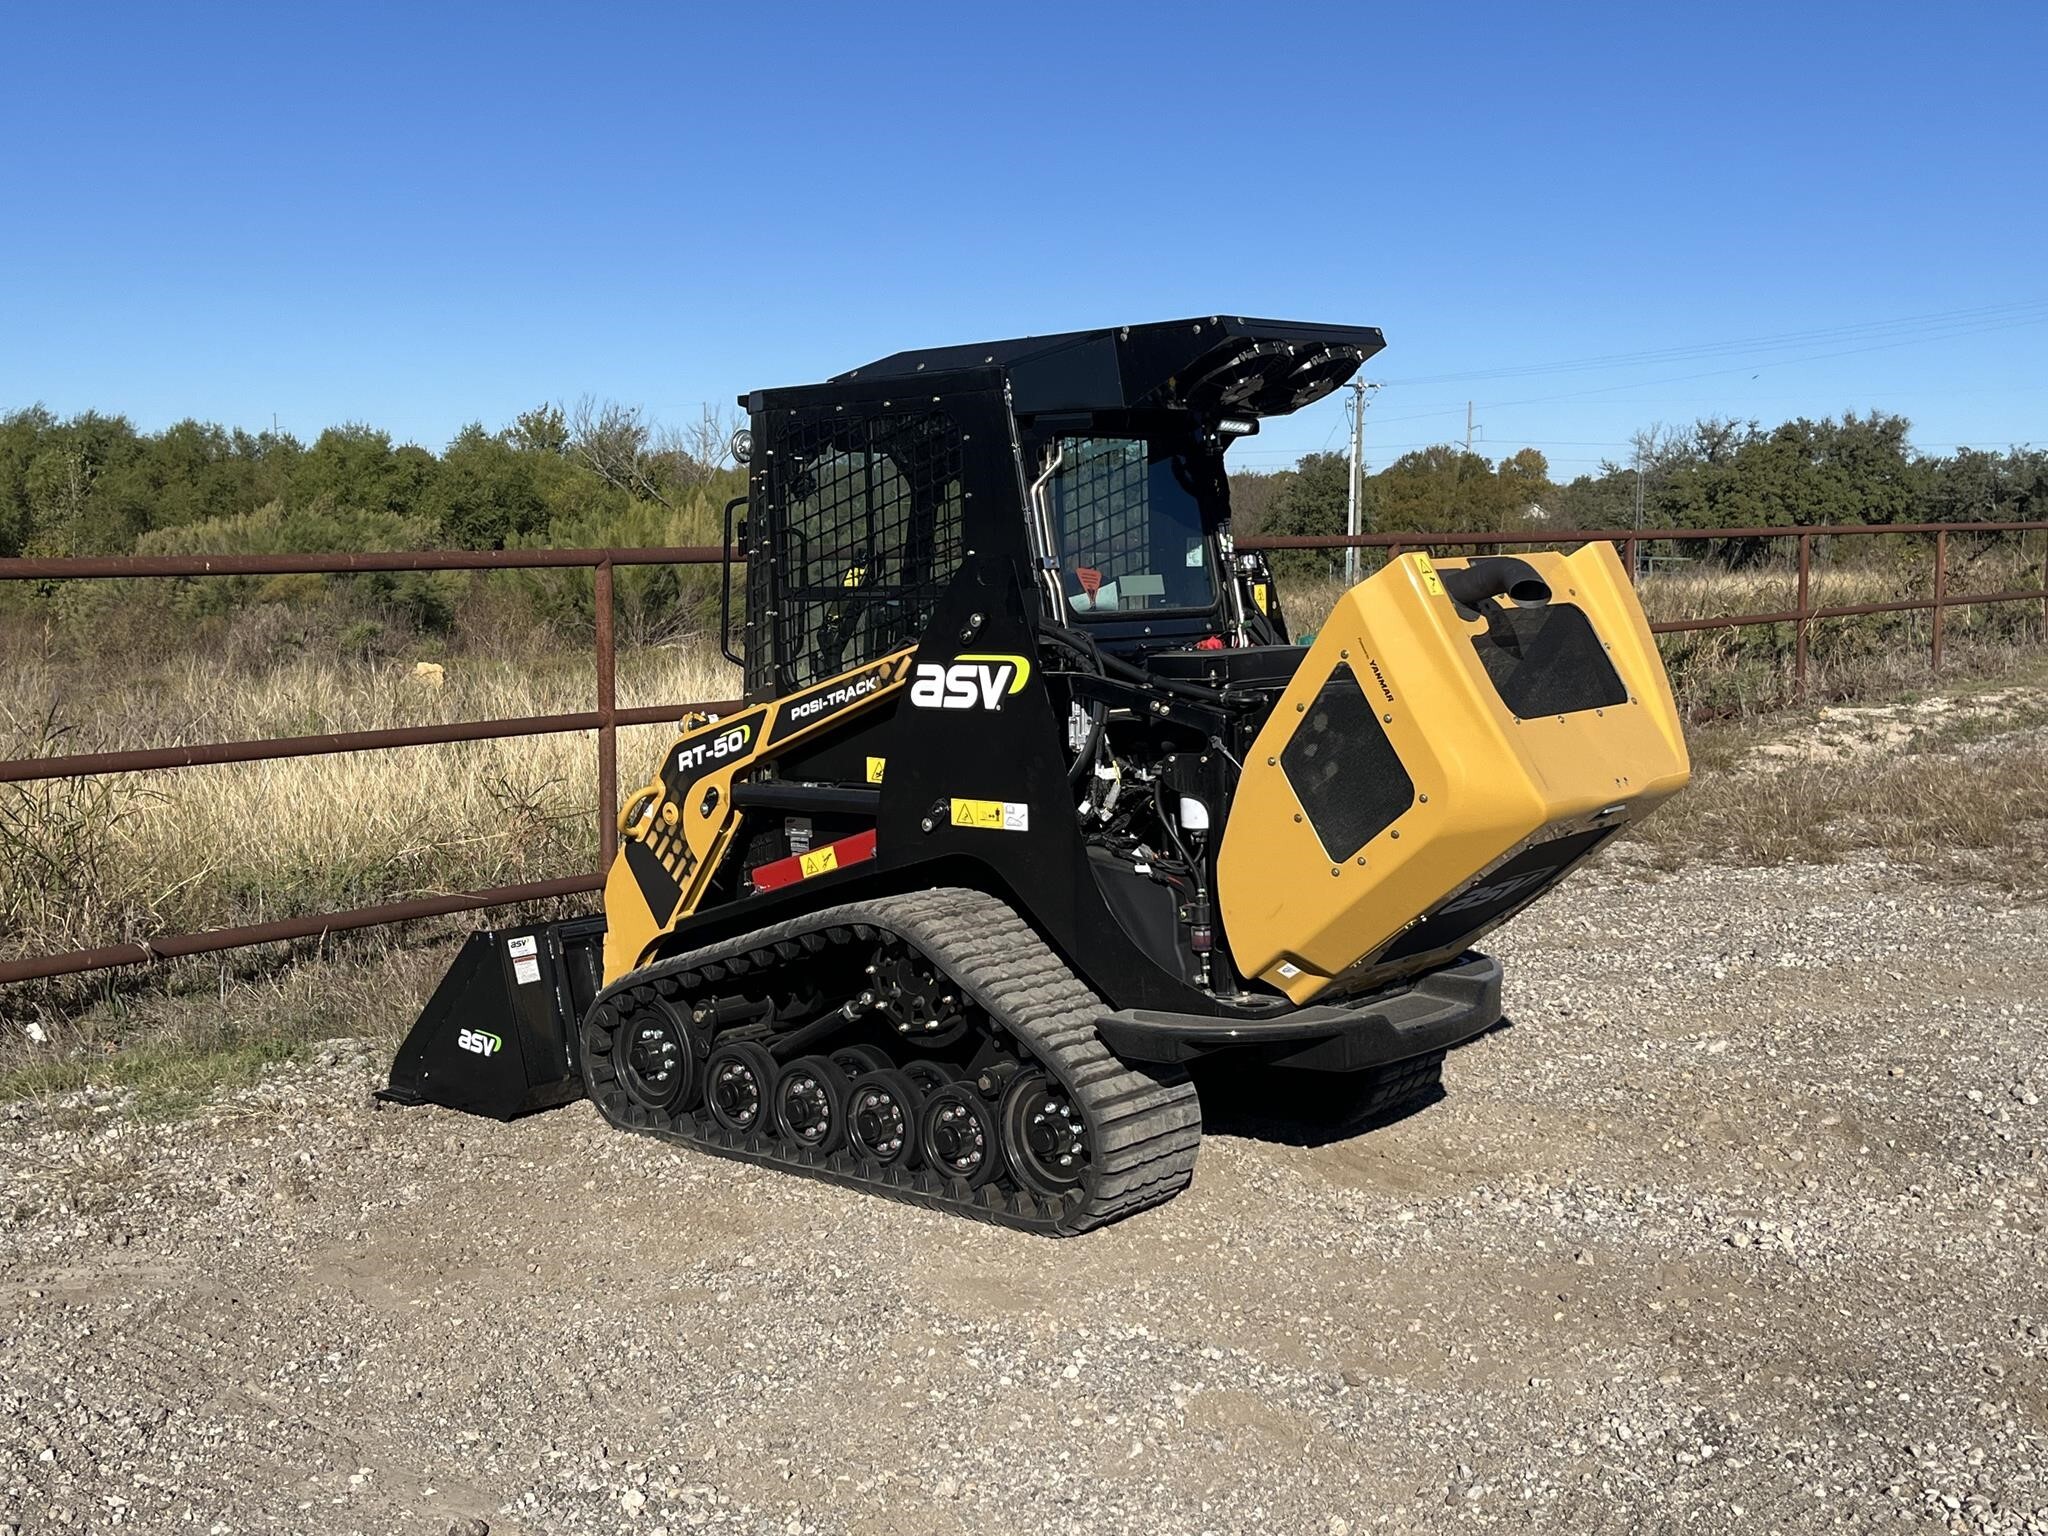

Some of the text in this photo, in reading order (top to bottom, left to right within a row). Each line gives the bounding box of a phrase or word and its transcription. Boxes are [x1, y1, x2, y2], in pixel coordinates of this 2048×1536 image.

[790, 677, 876, 721] POSI-TRACK
[1369, 659, 1394, 703] YANMAR
[678, 730, 743, 772] RT-50
